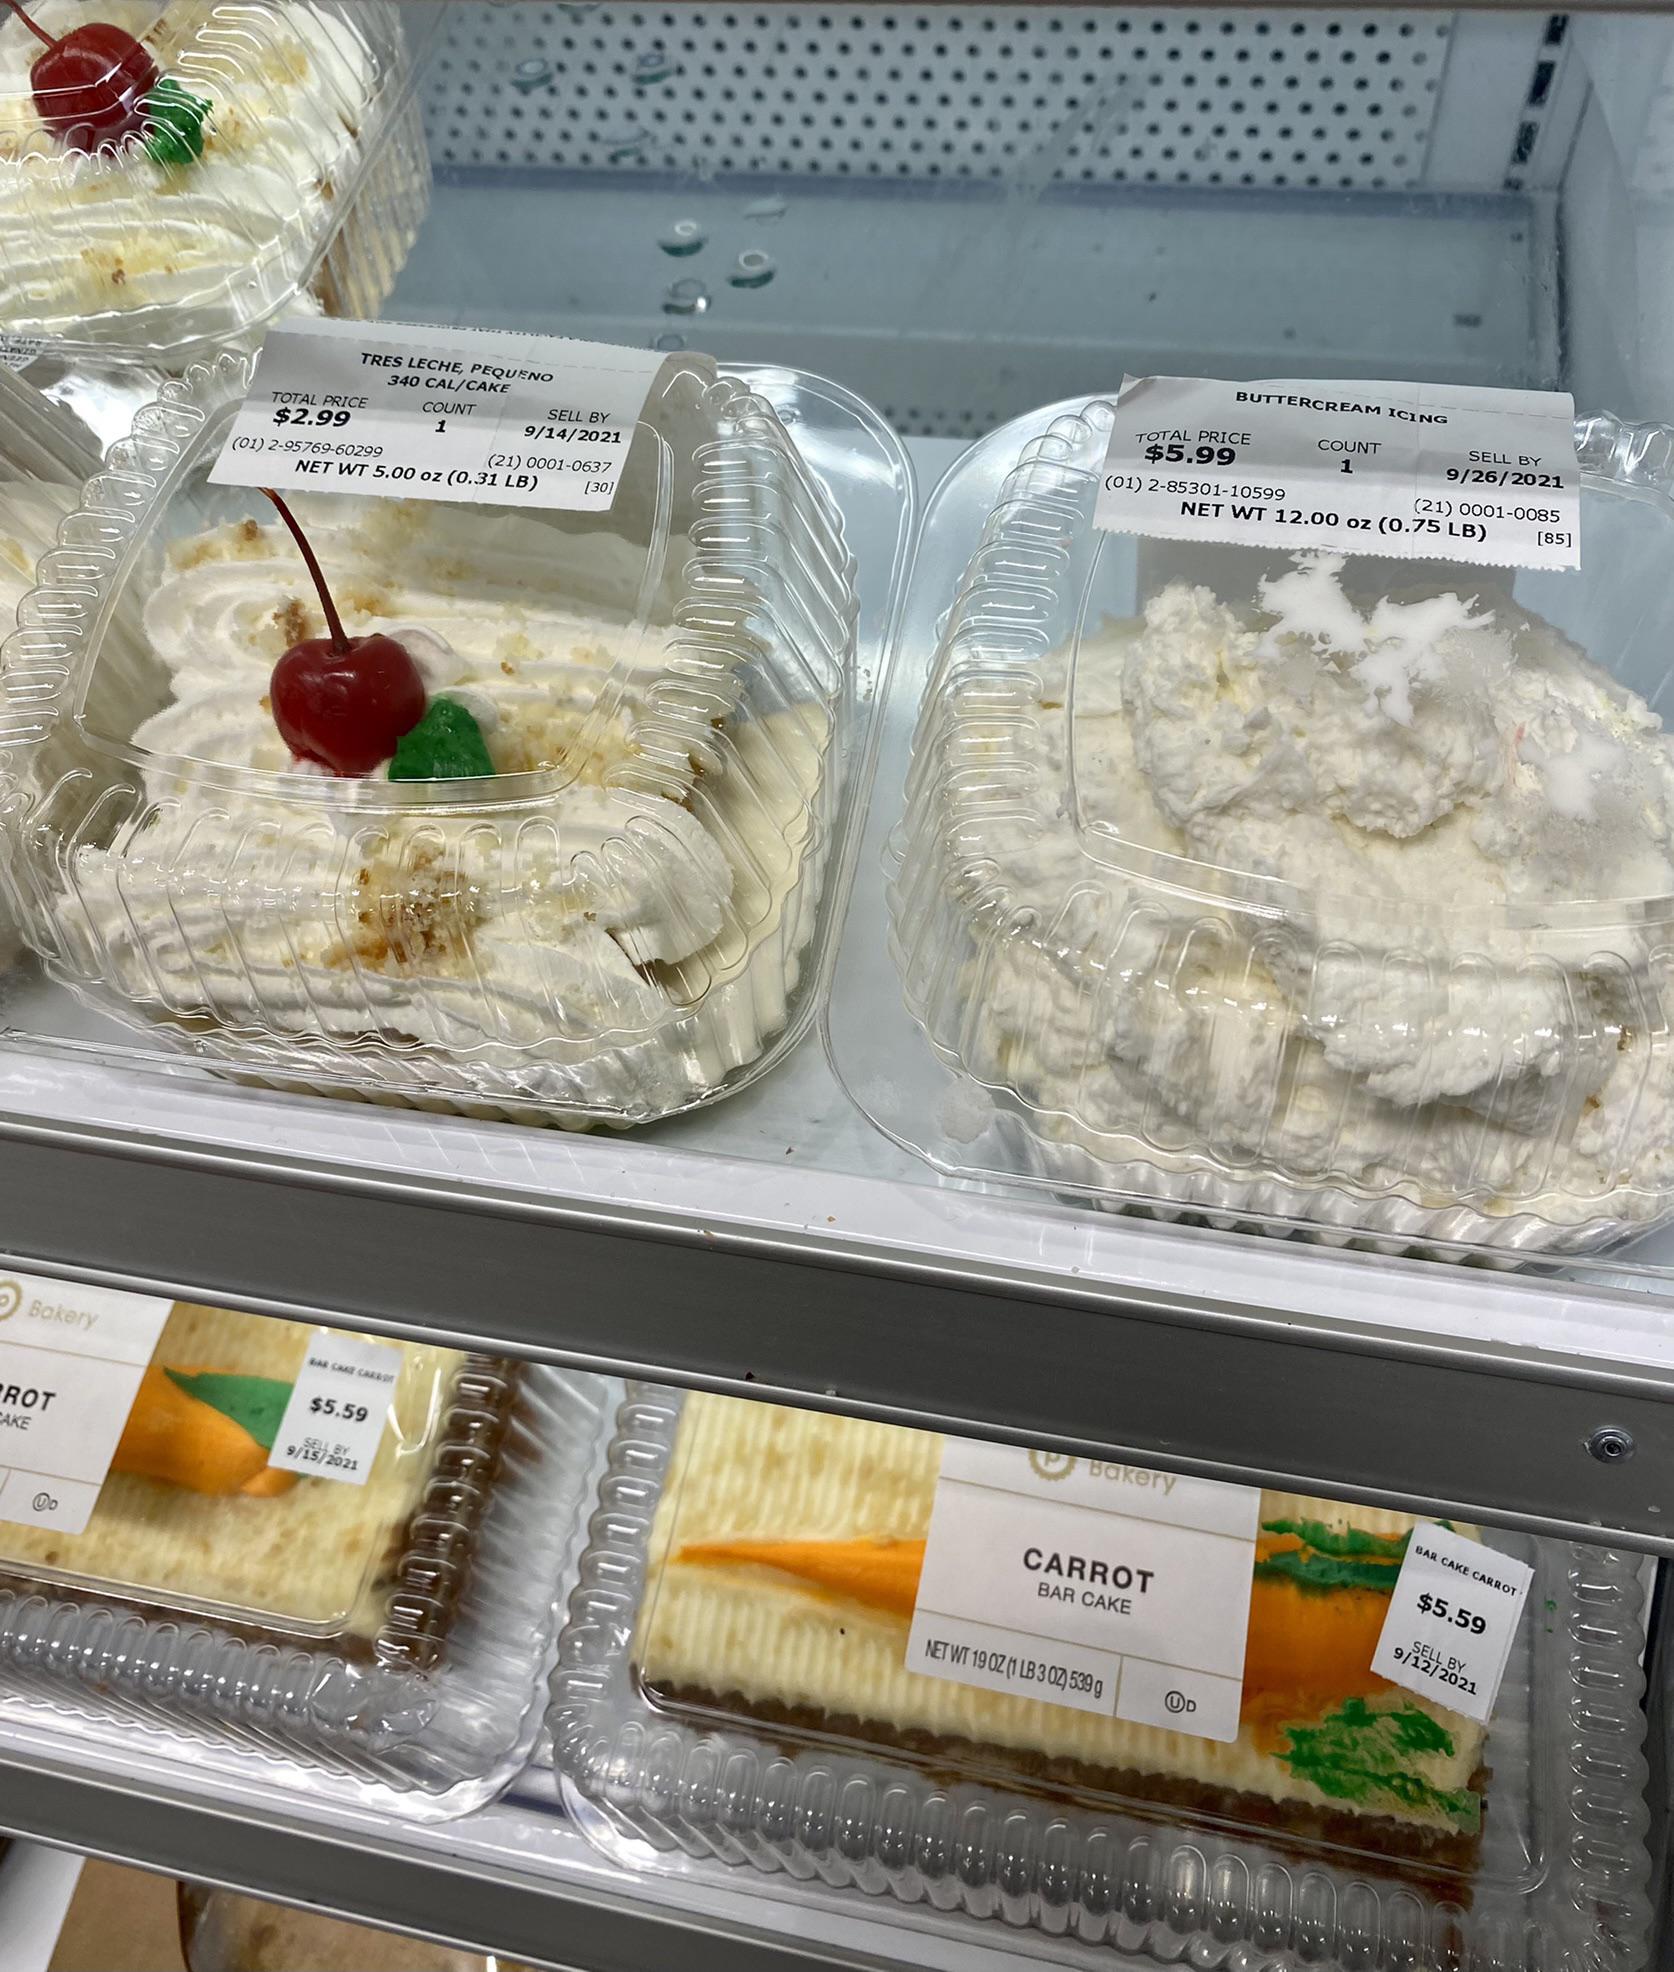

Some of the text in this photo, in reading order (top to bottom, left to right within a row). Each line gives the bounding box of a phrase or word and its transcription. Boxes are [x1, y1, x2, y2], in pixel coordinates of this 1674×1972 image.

[361, 352, 554, 382] TRES LECHE, PEQUENO
[387, 375, 511, 394] 340 CAL/CAKE
[271, 391, 369, 409] TOTAL PRICE
[422, 402, 477, 415] COUNT
[1236, 391, 1448, 424] BUTTERCREAM ICING
[273, 407, 351, 427] $2.99
[435, 420, 447, 433] 1
[547, 408, 611, 424] SELL BY
[524, 425, 622, 444] 9/14/2021
[1135, 430, 1252, 446] TOTAL PRICE
[232, 436, 383, 458] (01) 2-95769-60299
[1144, 444, 1236, 466] $5.99
[1318, 439, 1382, 454] COUNT
[487, 453, 612, 473] (21) 0001-0637
[1340, 459, 1353, 474] 1
[1469, 451, 1542, 467] SELL BY
[295, 459, 538, 492] NET WT 5.00 oz (0.31 LB)
[1446, 468, 1564, 489] 9/26/2021
[584, 480, 615, 495] [30]
[1105, 475, 1286, 500] (01) 2-85301-10599
[1180, 501, 1487, 542] NET WT 12.00 oz (0.75 LB)
[1414, 498, 1561, 523] (21) 0001-0085
[1537, 531, 1572, 548] [85]
[28, 1299, 99, 1331] Bakery
[0, 1384, 56, 1411] ROT
[310, 1395, 368, 1422] $5.59
[287, 1445, 358, 1470] 9/15/2021
[304, 1437, 350, 1456] SELL BY
[1089, 1459, 1177, 1496] Bakery
[1022, 1547, 1154, 1594] CARROT
[1415, 1545, 1518, 1597] BAR CAKE CARROT
[1037, 1582, 1133, 1616] BAR CAKE
[1416, 1592, 1487, 1635] $5.59
[925, 1639, 950, 1661] NET
[950, 1644, 970, 1665] WT
[972, 1649, 987, 1669] 19
[988, 1652, 1006, 1674] OZ
[1019, 1658, 1036, 1680] LB
[1037, 1663, 1046, 1682] 3
[1049, 1665, 1068, 1691] OZ)
[1411, 1641, 1467, 1674] SELL BY
[1392, 1647, 1478, 1696] 9/12/2021
